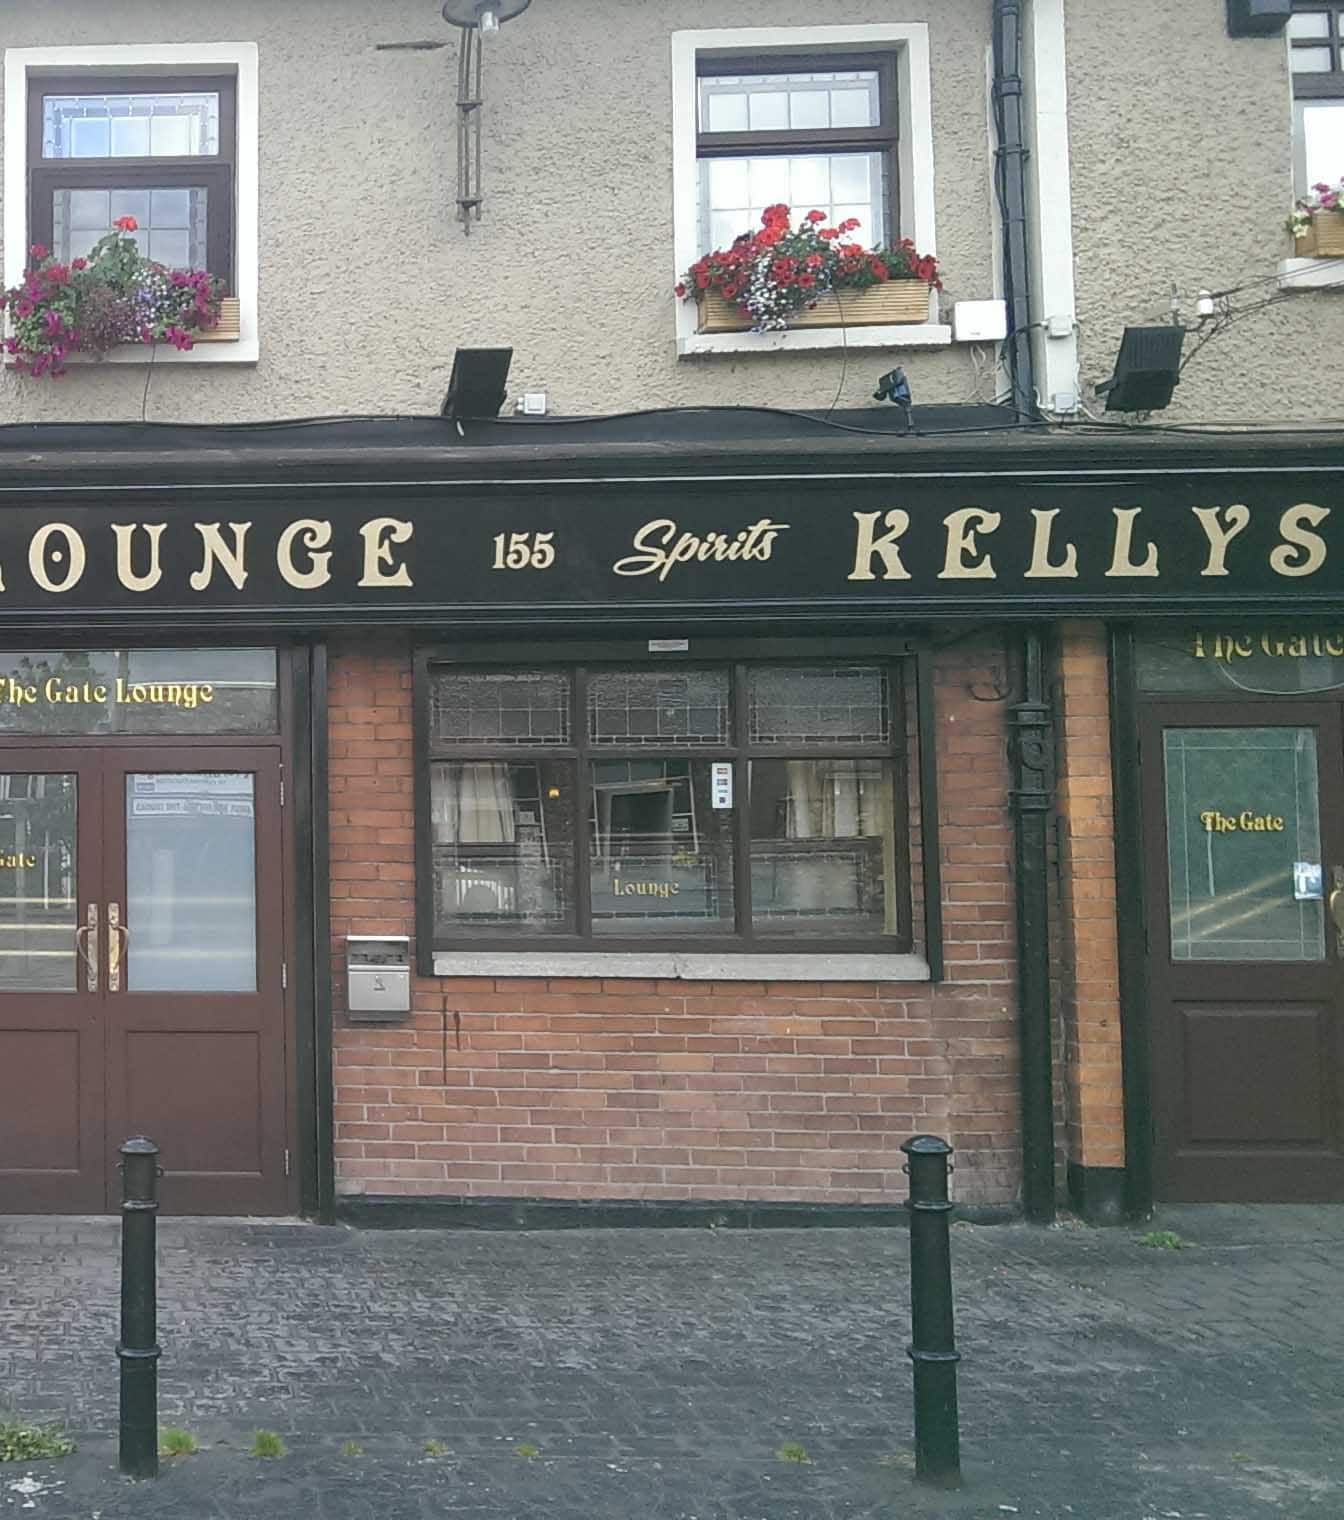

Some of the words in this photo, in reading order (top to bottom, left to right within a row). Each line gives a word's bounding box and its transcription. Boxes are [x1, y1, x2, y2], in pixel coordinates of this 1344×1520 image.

[493, 531, 555, 569] 155
[613, 519, 790, 581] Spirits
[848, 504, 1330, 579] KELLYS
[45, 678, 106, 703] Gate
[116, 678, 214, 708] Lounge
[1200, 811, 1237, 832] The
[1240, 811, 1285, 831] Gate
[612, 878, 680, 898] Lounge
